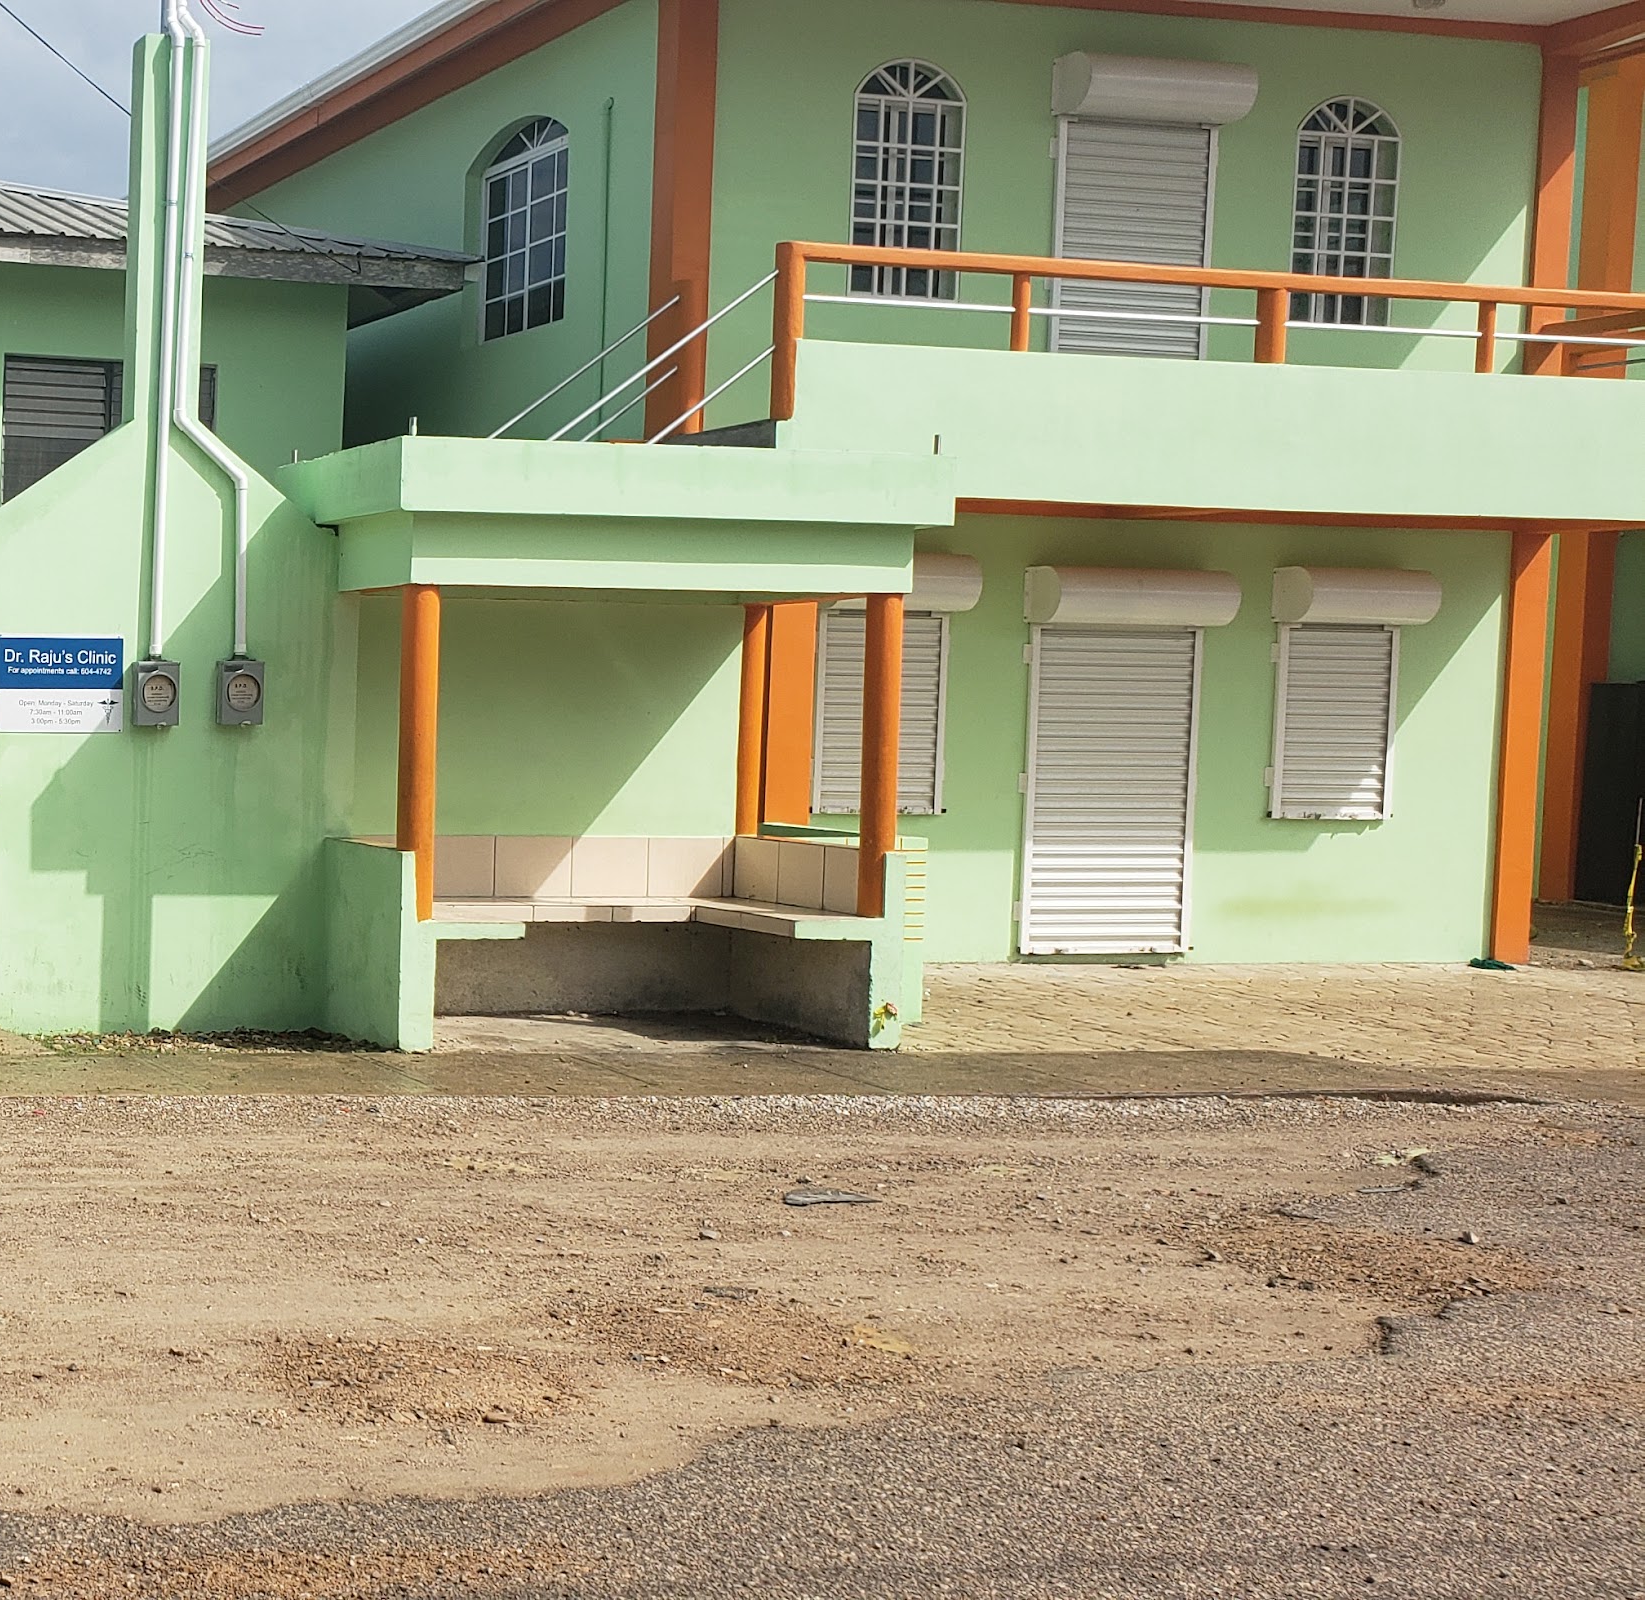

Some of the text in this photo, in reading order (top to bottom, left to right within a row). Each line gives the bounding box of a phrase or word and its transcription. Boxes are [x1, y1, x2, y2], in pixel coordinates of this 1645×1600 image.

[3, 648, 117, 666] Dr. Raju's Clinic
[7, 666, 19, 674] For
[20, 667, 65, 676] appointments
[38, 699, 62, 707] Monday
[67, 699, 94, 708] Saturday
